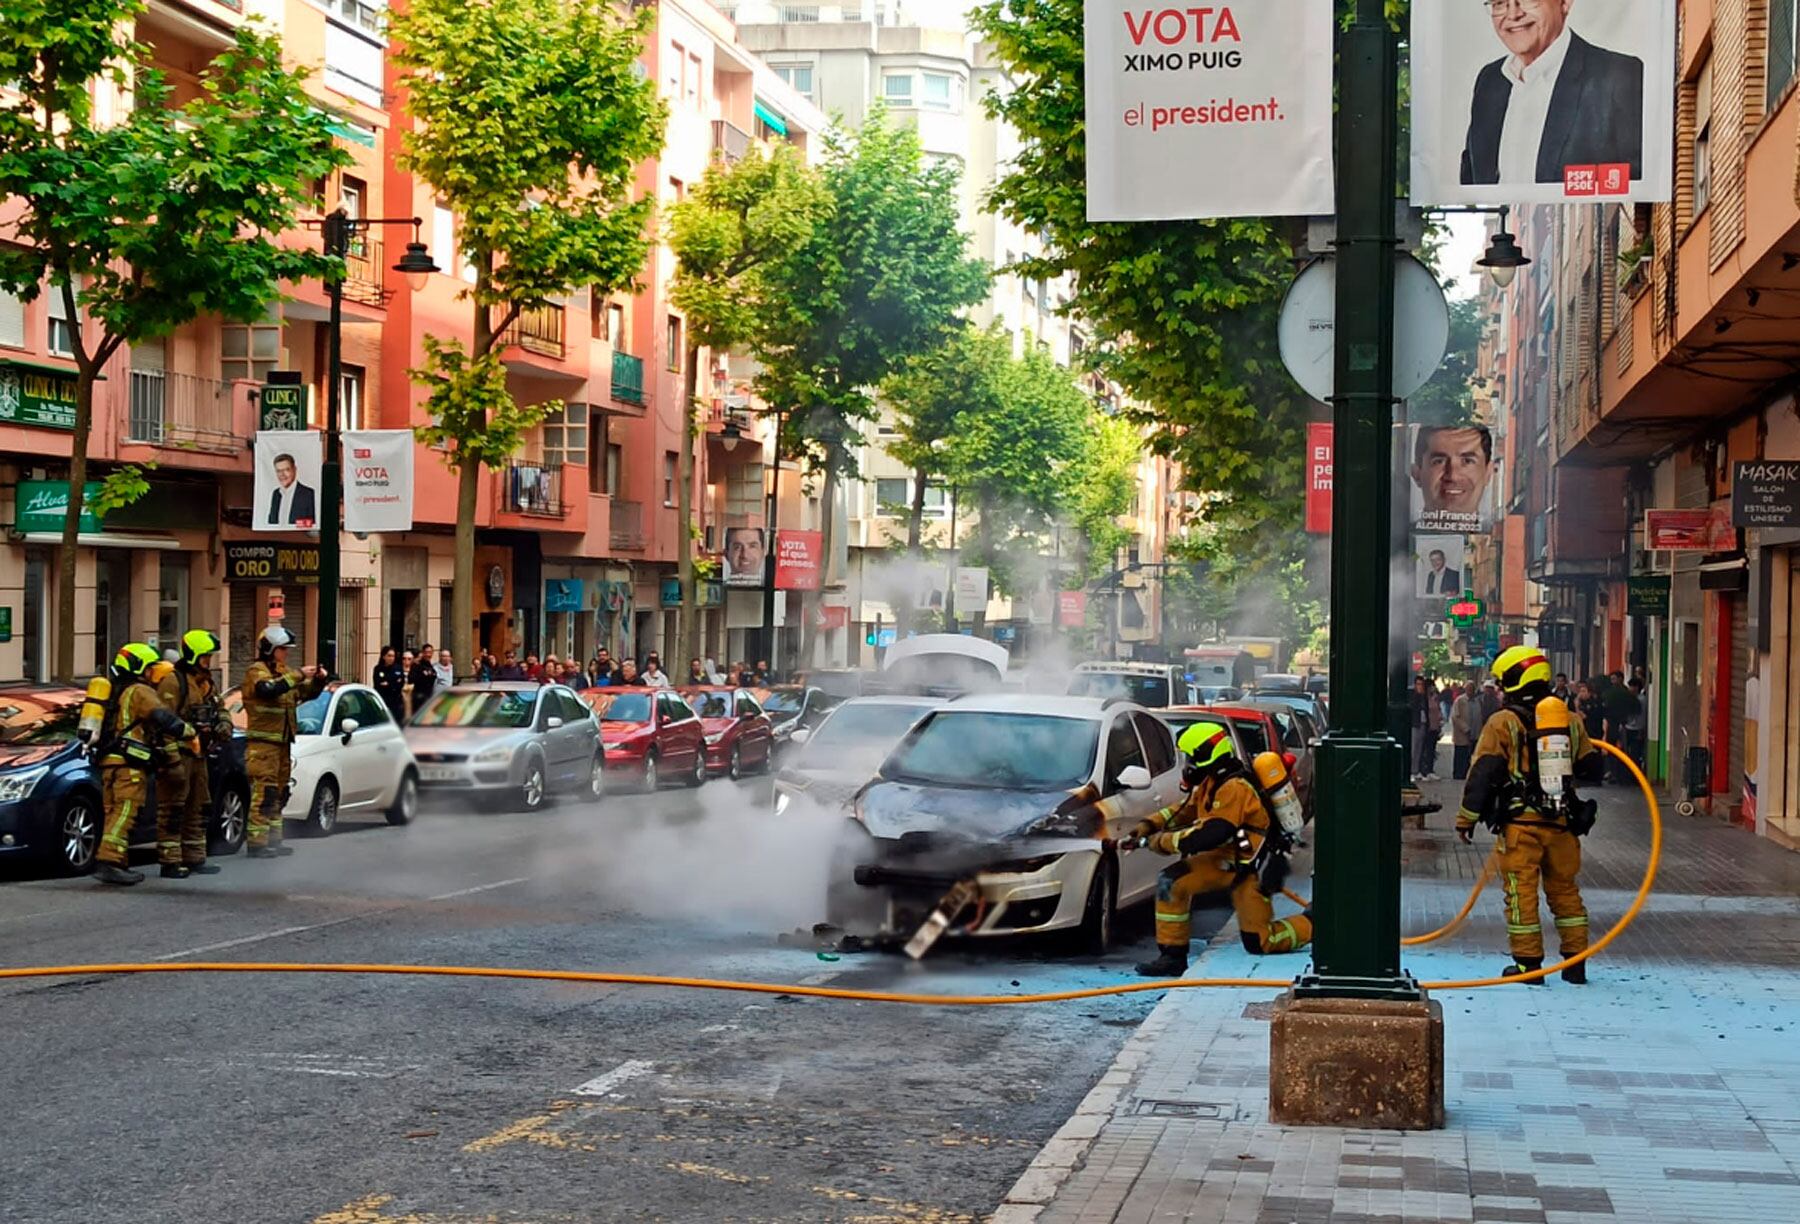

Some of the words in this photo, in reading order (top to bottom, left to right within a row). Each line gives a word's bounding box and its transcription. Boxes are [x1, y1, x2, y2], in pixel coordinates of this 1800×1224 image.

[1123, 7, 1241, 46] VOTA
[1124, 53, 1183, 72] XIMO
[1188, 50, 1242, 70] PUIG
[1124, 101, 1144, 127] el
[1152, 97, 1285, 132] president.
[1567, 170, 1594, 181] PSPV
[1567, 180, 1594, 191] PSOE
[1314, 446, 1330, 460] El
[355, 467, 389, 479] VOTA
[1740, 464, 1799, 481] MASAK
[1762, 495, 1774, 503] DE
[1744, 504, 1792, 513] ESTILISMO
[1750, 514, 1785, 522] UNISEX
[1416, 521, 1457, 531] ALCALDE
[780, 540, 806, 551] VOTA
[229, 546, 275, 559] COMPRO
[235, 560, 270, 577] ORO
